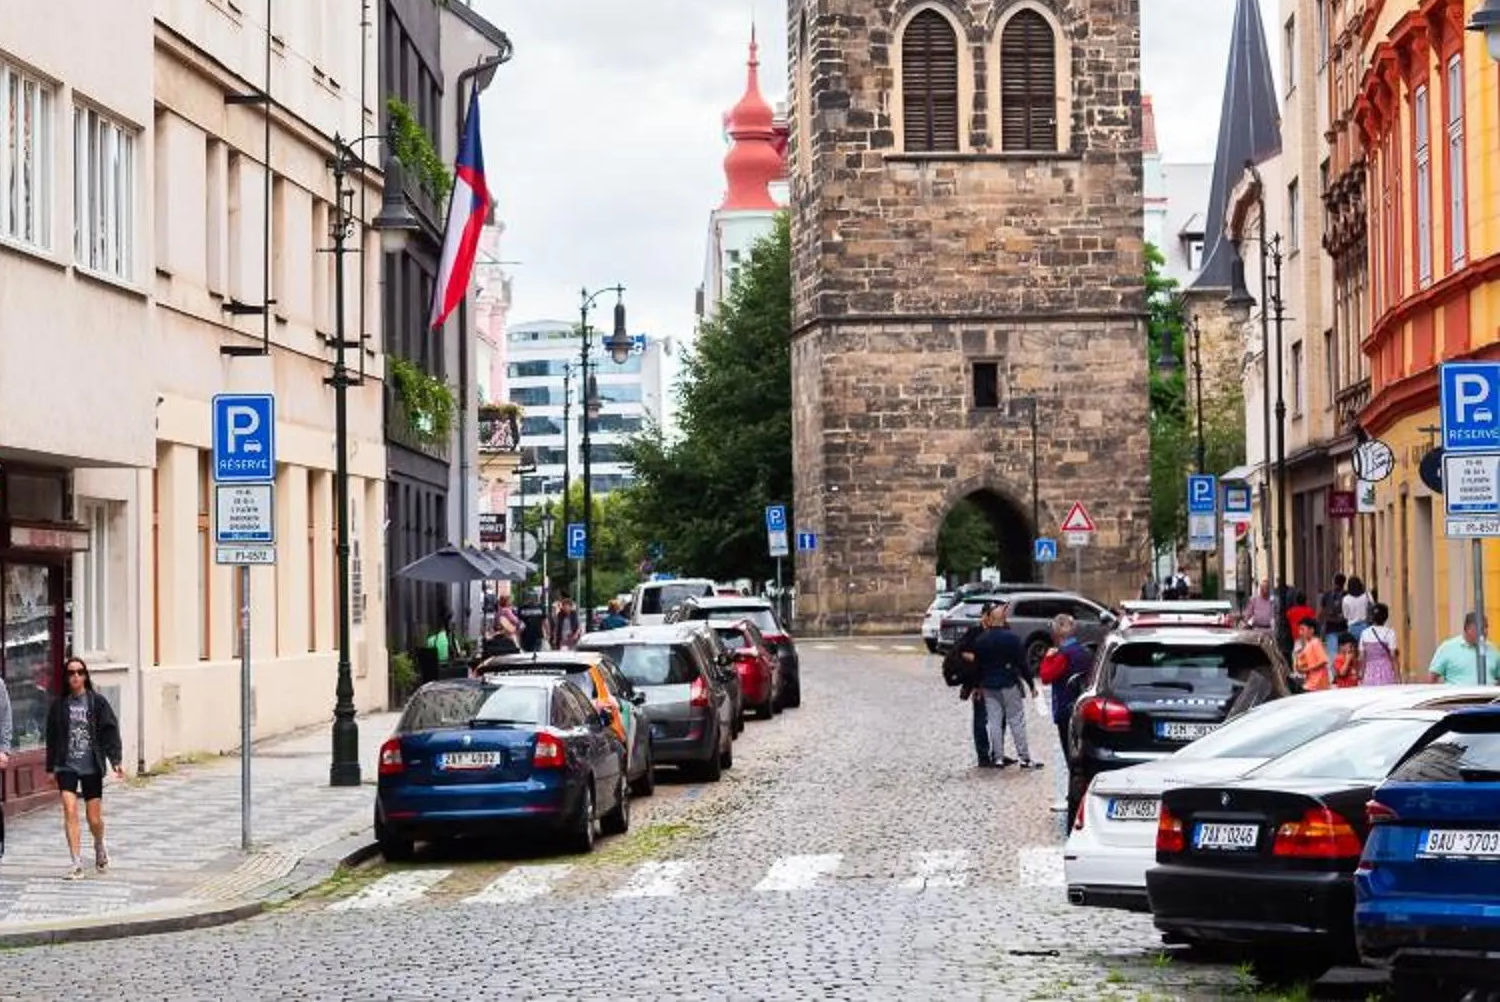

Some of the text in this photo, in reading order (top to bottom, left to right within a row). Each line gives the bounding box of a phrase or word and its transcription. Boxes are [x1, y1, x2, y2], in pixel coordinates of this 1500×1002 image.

[1455, 373, 1490, 423] P
[227, 405, 261, 454] P
[1194, 480, 1209, 503] P
[770, 509, 781, 525] P
[573, 529, 586, 547] P
[1429, 833, 1499, 852] 9AU 3703
